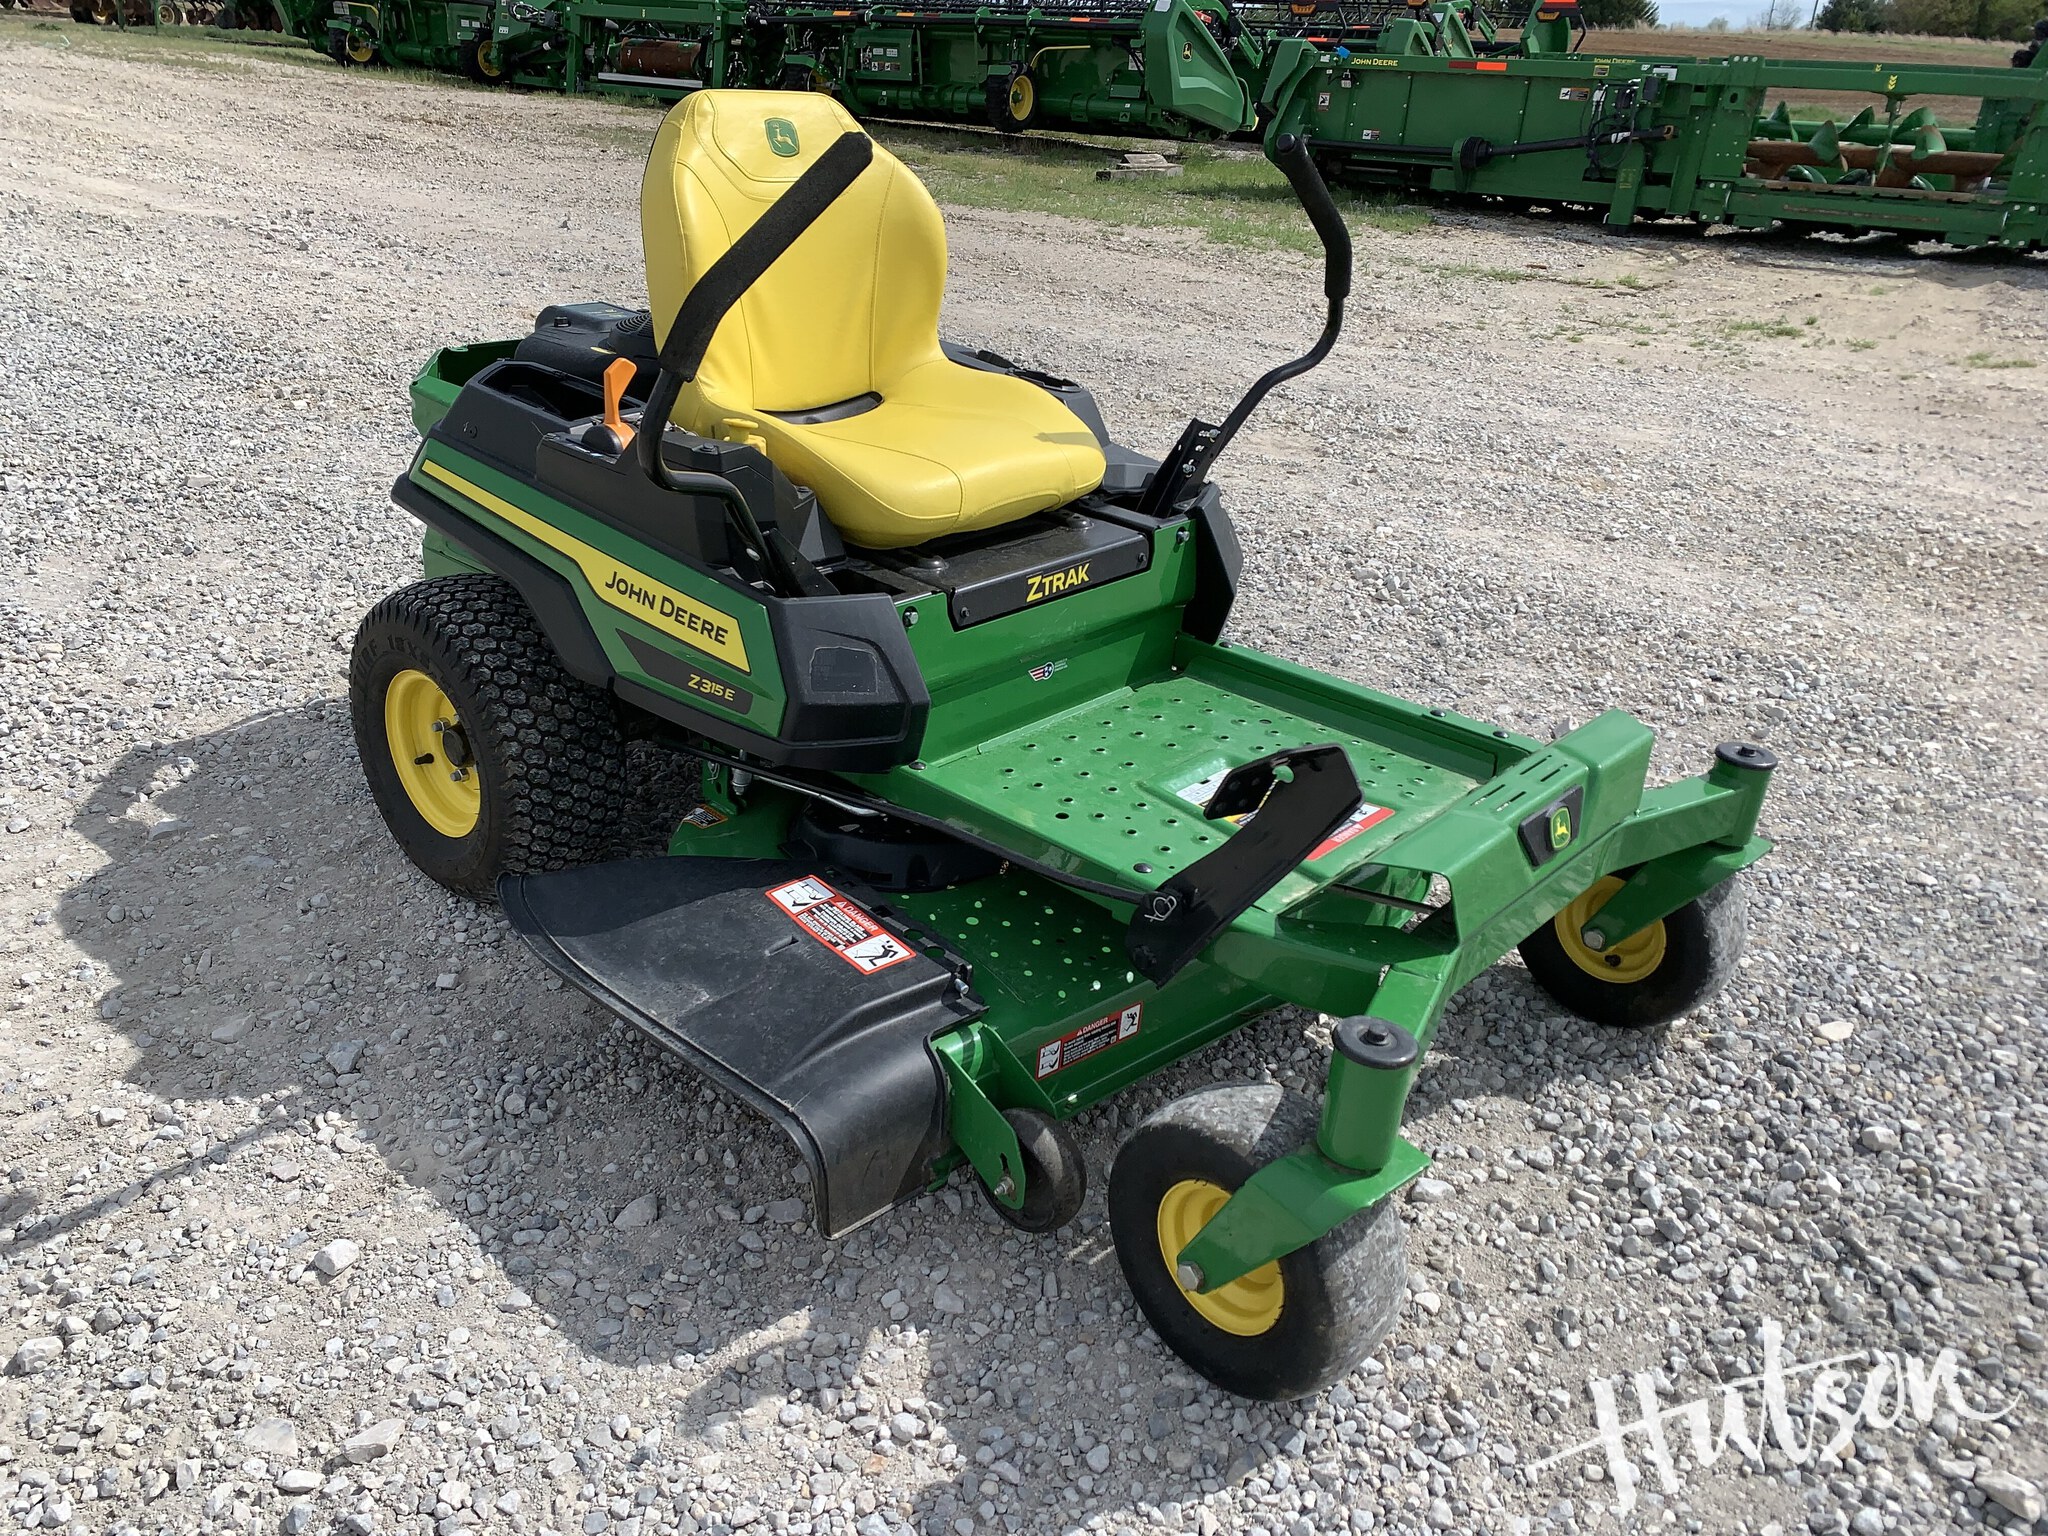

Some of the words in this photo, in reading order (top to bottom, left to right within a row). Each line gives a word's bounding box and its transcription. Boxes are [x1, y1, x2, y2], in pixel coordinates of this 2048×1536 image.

[1351, 57, 1371, 65] JOHN
[1372, 58, 1398, 66] DEERE
[1026, 562, 1091, 602] ZTRAK
[605, 571, 656, 610] JOHN
[659, 595, 729, 645] DEERE
[846, 905, 879, 932] DANGER
[1083, 1017, 1109, 1033] DANGER
